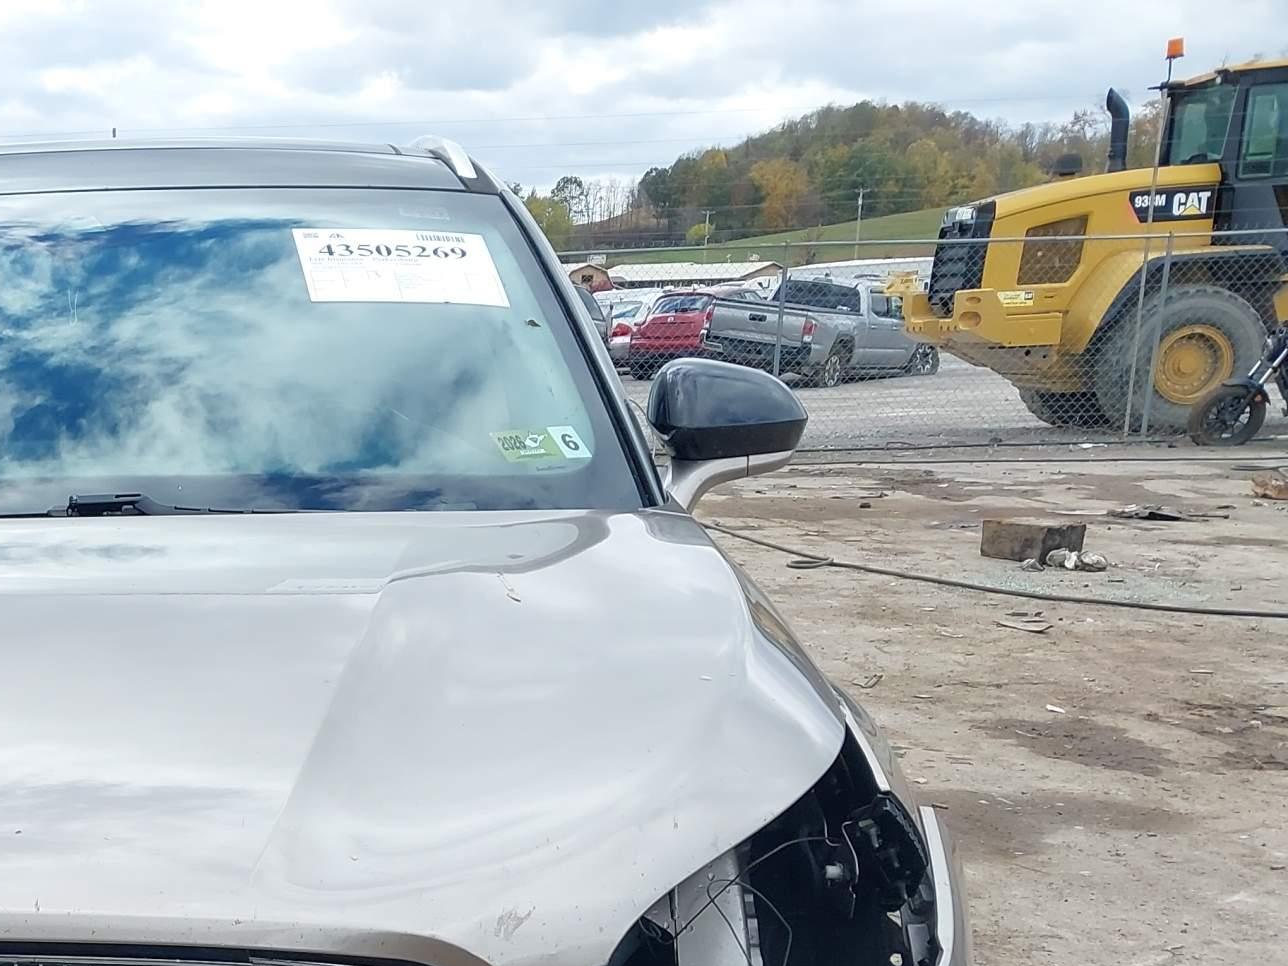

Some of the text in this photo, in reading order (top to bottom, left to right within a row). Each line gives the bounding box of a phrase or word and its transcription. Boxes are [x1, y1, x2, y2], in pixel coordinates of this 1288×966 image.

[1134, 190, 1212, 217] 93M CAT
[318, 243, 468, 259] 43505269
[561, 433, 580, 451] 6
